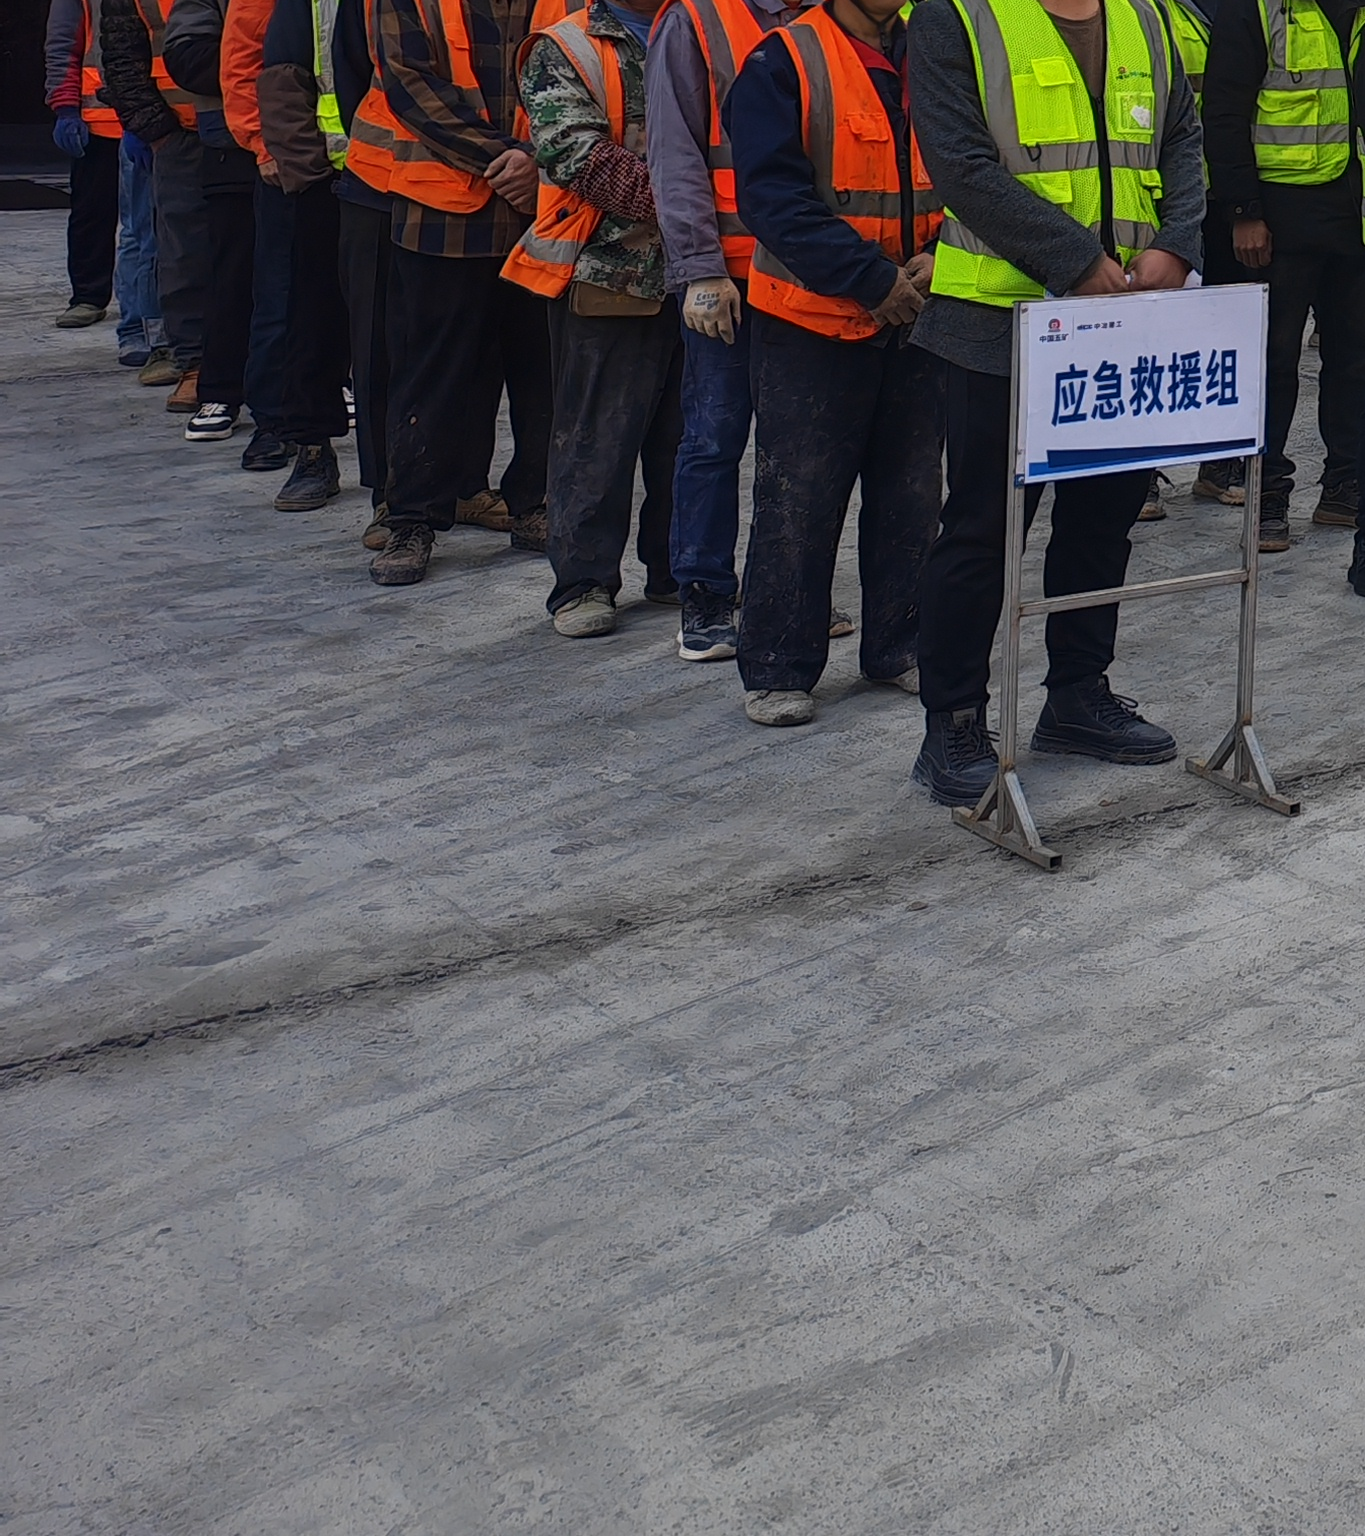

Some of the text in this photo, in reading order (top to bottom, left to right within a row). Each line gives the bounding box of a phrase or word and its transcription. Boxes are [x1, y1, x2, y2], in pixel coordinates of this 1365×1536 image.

[1051, 348, 1239, 428] 应急救援组
